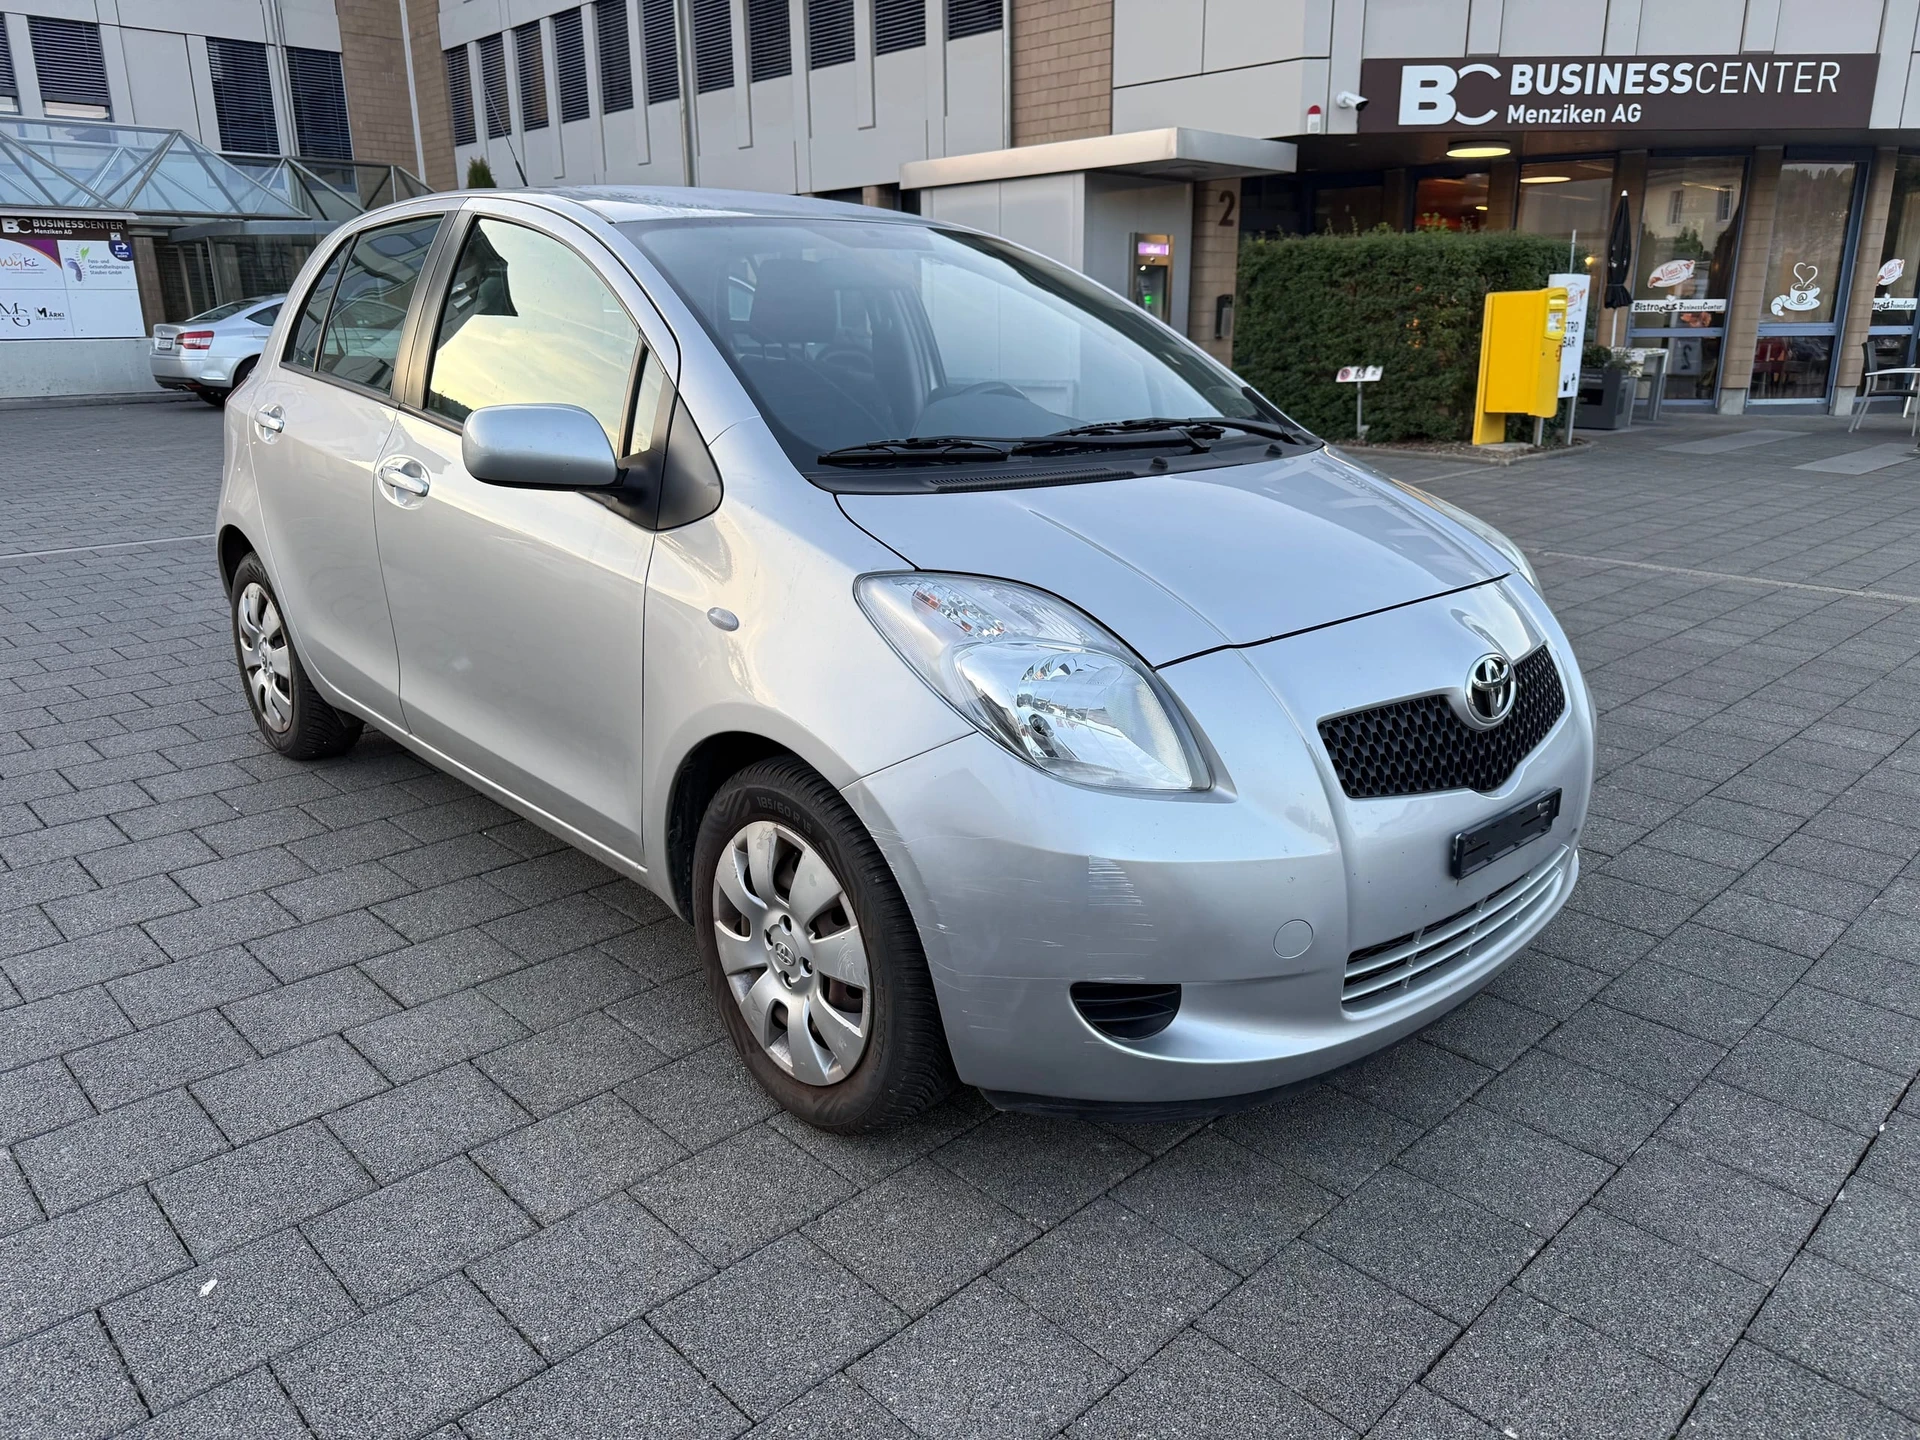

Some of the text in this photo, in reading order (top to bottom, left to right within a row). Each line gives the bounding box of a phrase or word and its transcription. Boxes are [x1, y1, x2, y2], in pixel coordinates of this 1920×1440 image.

[1509, 61, 1841, 96] BUSINESSCENTER
[1398, 63, 1502, 126] BC
[1506, 103, 1642, 125] Menziken AG
[1218, 190, 1236, 227] 2
[1, 217, 31, 234] BC
[32, 218, 124, 230] BUSINESSCENTER
[1634, 302, 1660, 311] Bistro
